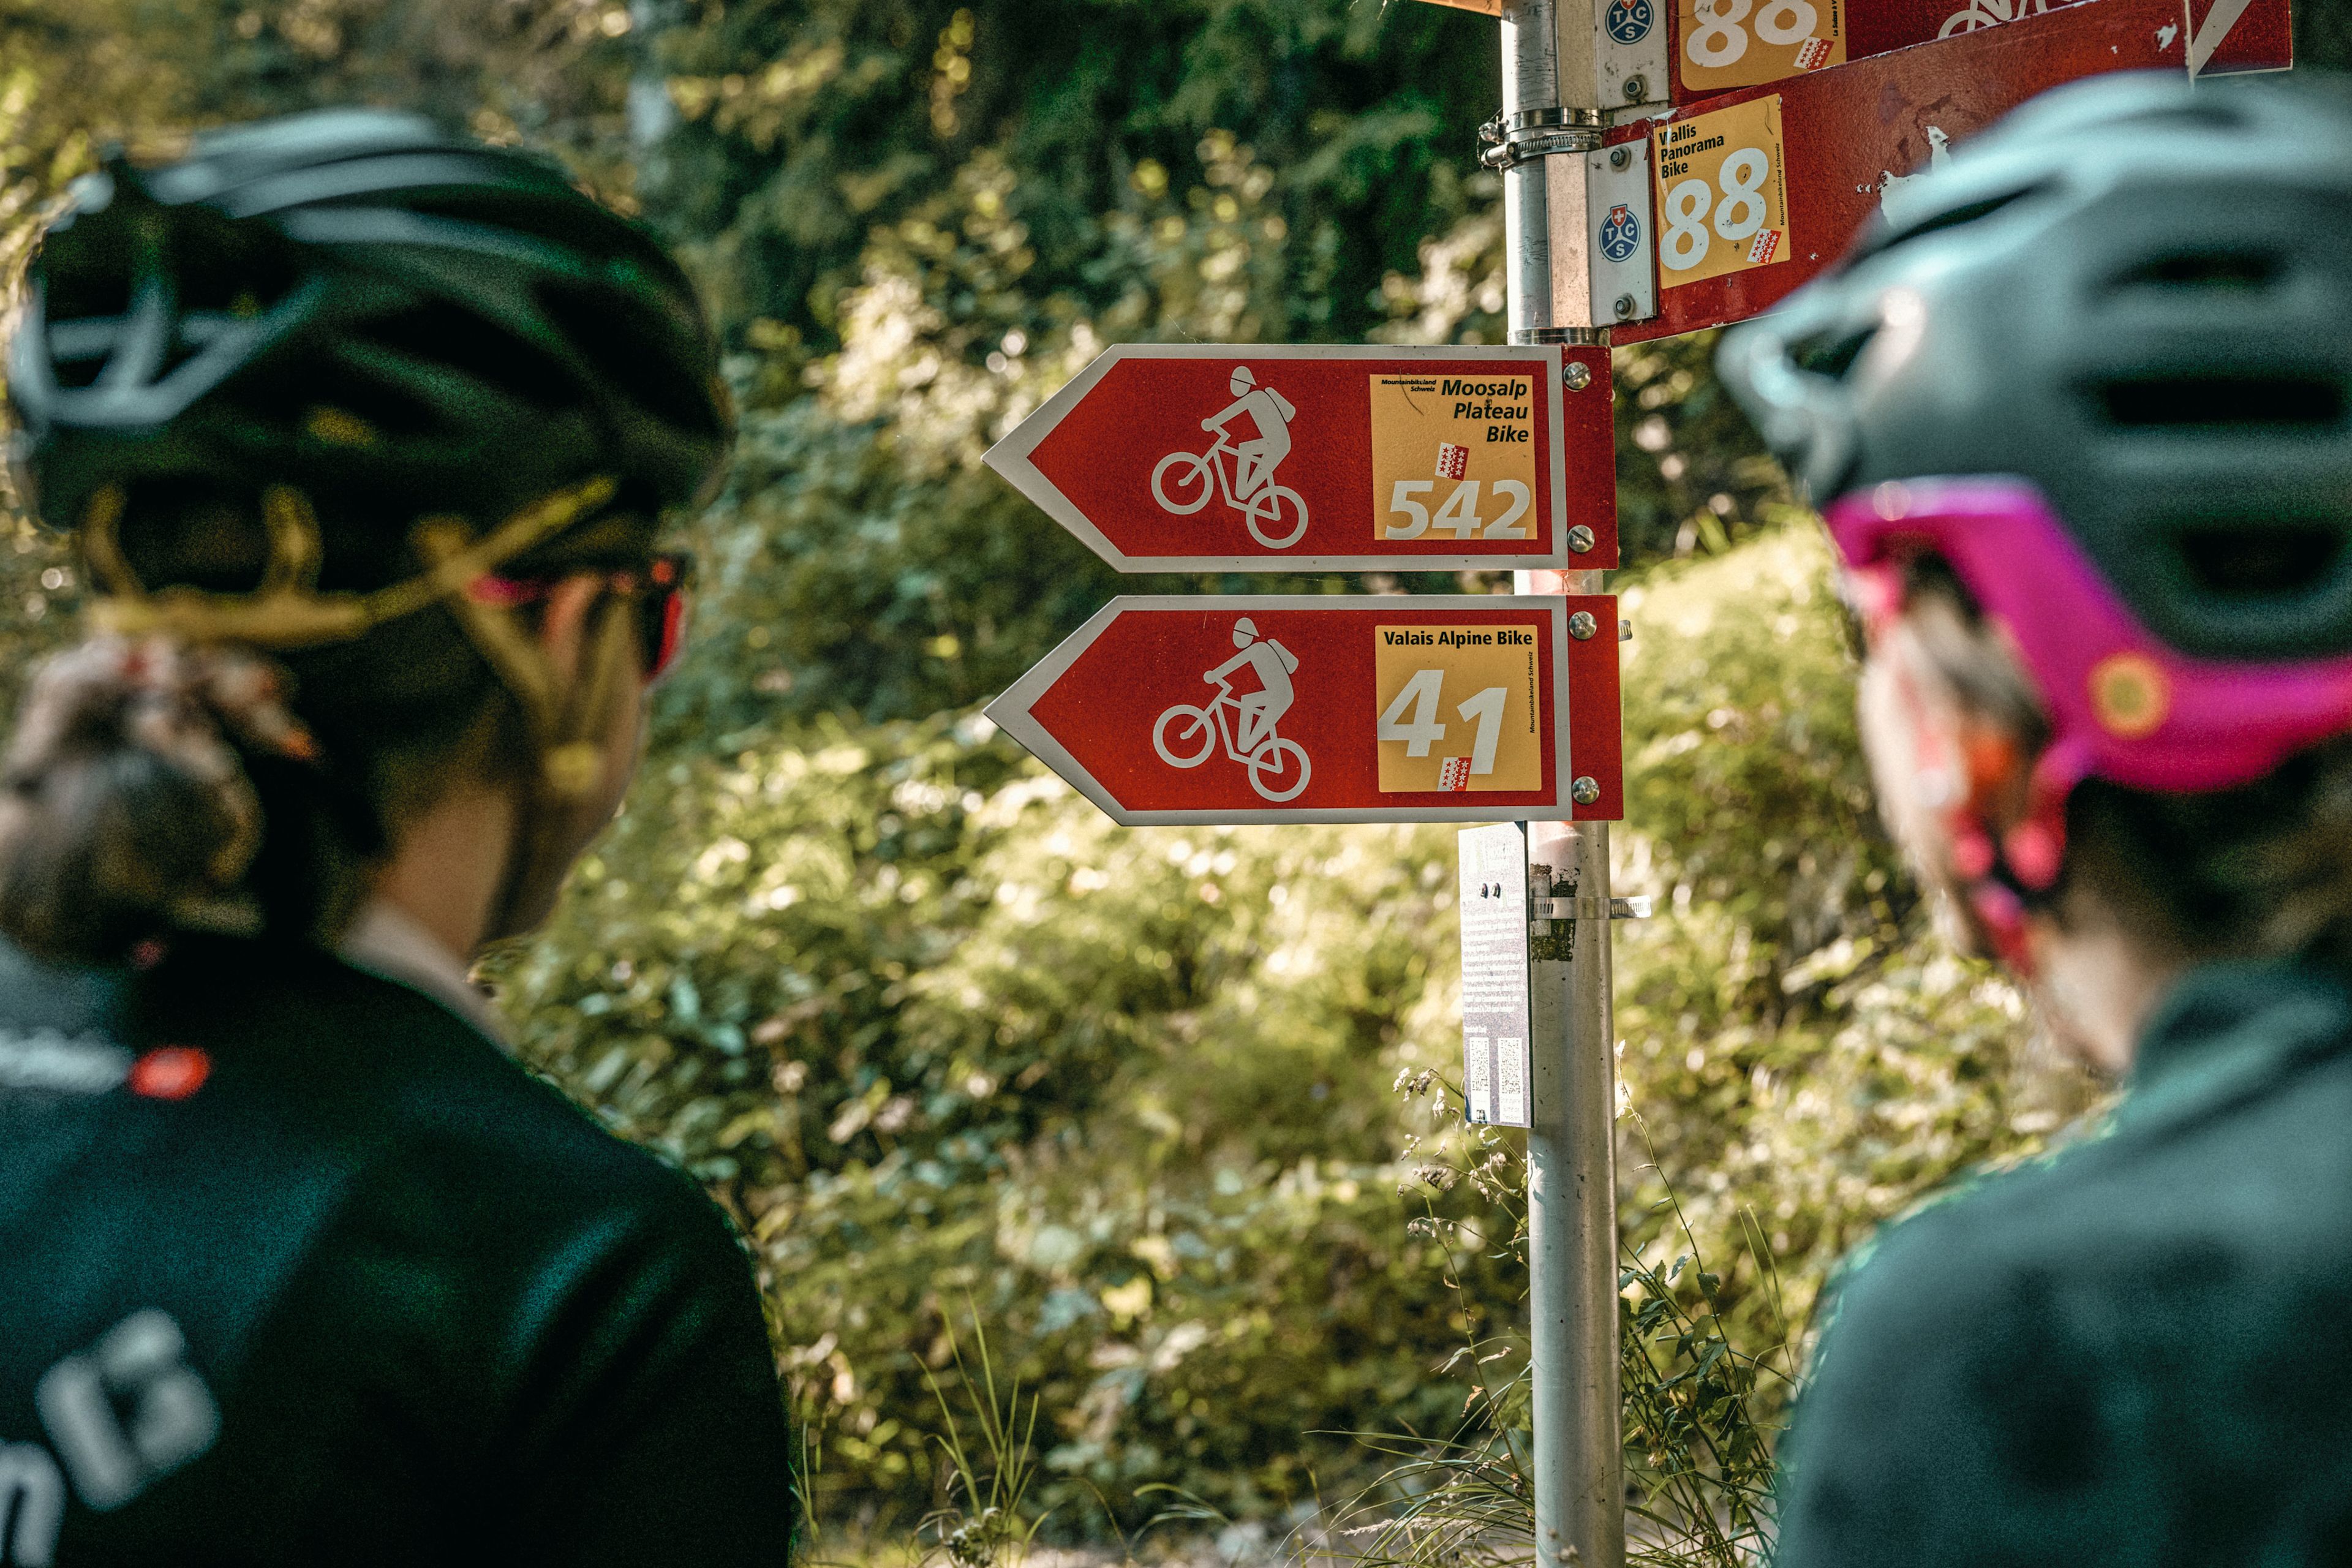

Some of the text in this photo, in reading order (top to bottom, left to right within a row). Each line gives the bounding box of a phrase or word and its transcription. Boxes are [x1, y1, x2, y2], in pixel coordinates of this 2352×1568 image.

[1613, 6, 1647, 39] TCS
[1659, 124, 1697, 146] Wallis
[1660, 135, 1724, 162] Panorama
[1662, 161, 1688, 179] Bike
[1659, 147, 1770, 271] 88
[1605, 223, 1635, 257] TCS
[1441, 379, 1528, 400] Moosalp
[1453, 401, 1528, 419] Plateau
[1487, 424, 1529, 442] Bike
[1385, 480, 1531, 540] 542
[1384, 630, 1532, 649] Valais Alpine Bike
[1377, 669, 1507, 774] 41
